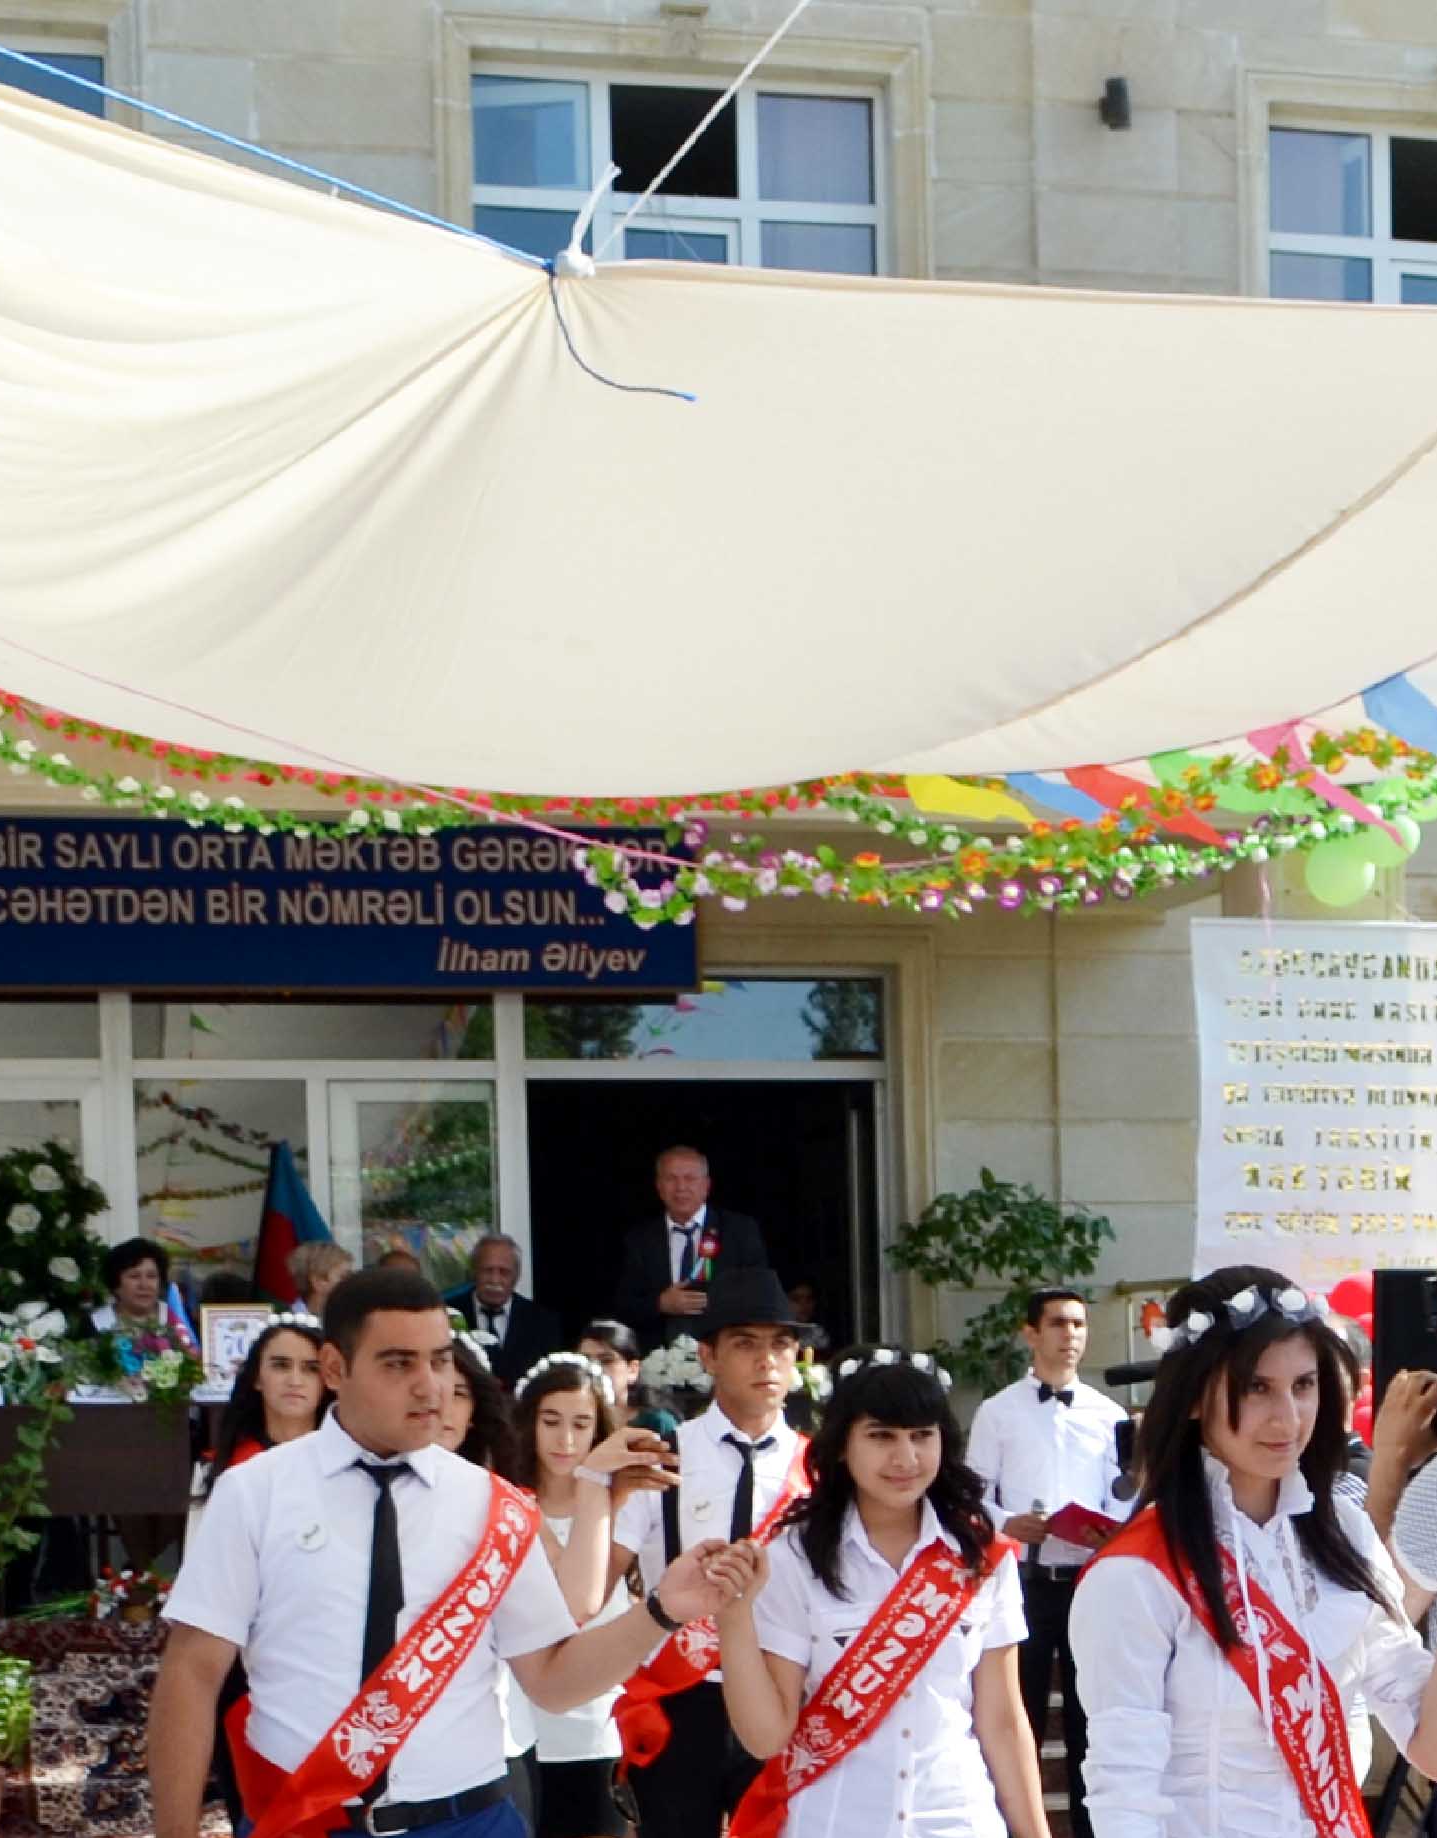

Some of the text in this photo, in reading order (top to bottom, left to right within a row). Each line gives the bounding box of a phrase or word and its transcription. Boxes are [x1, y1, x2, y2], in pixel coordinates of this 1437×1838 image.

[53, 833, 161, 871] SAYLI
[172, 834, 272, 872] ORTA
[283, 836, 442, 873] MƏKTƏB
[206, 883, 268, 925] BİR
[278, 882, 444, 925] NÖMRƏLİ
[437, 937, 647, 980] İlham Əliyev
[396, 1547, 510, 1694] MƏZUN
[831, 1581, 951, 1722] MƏZUN
